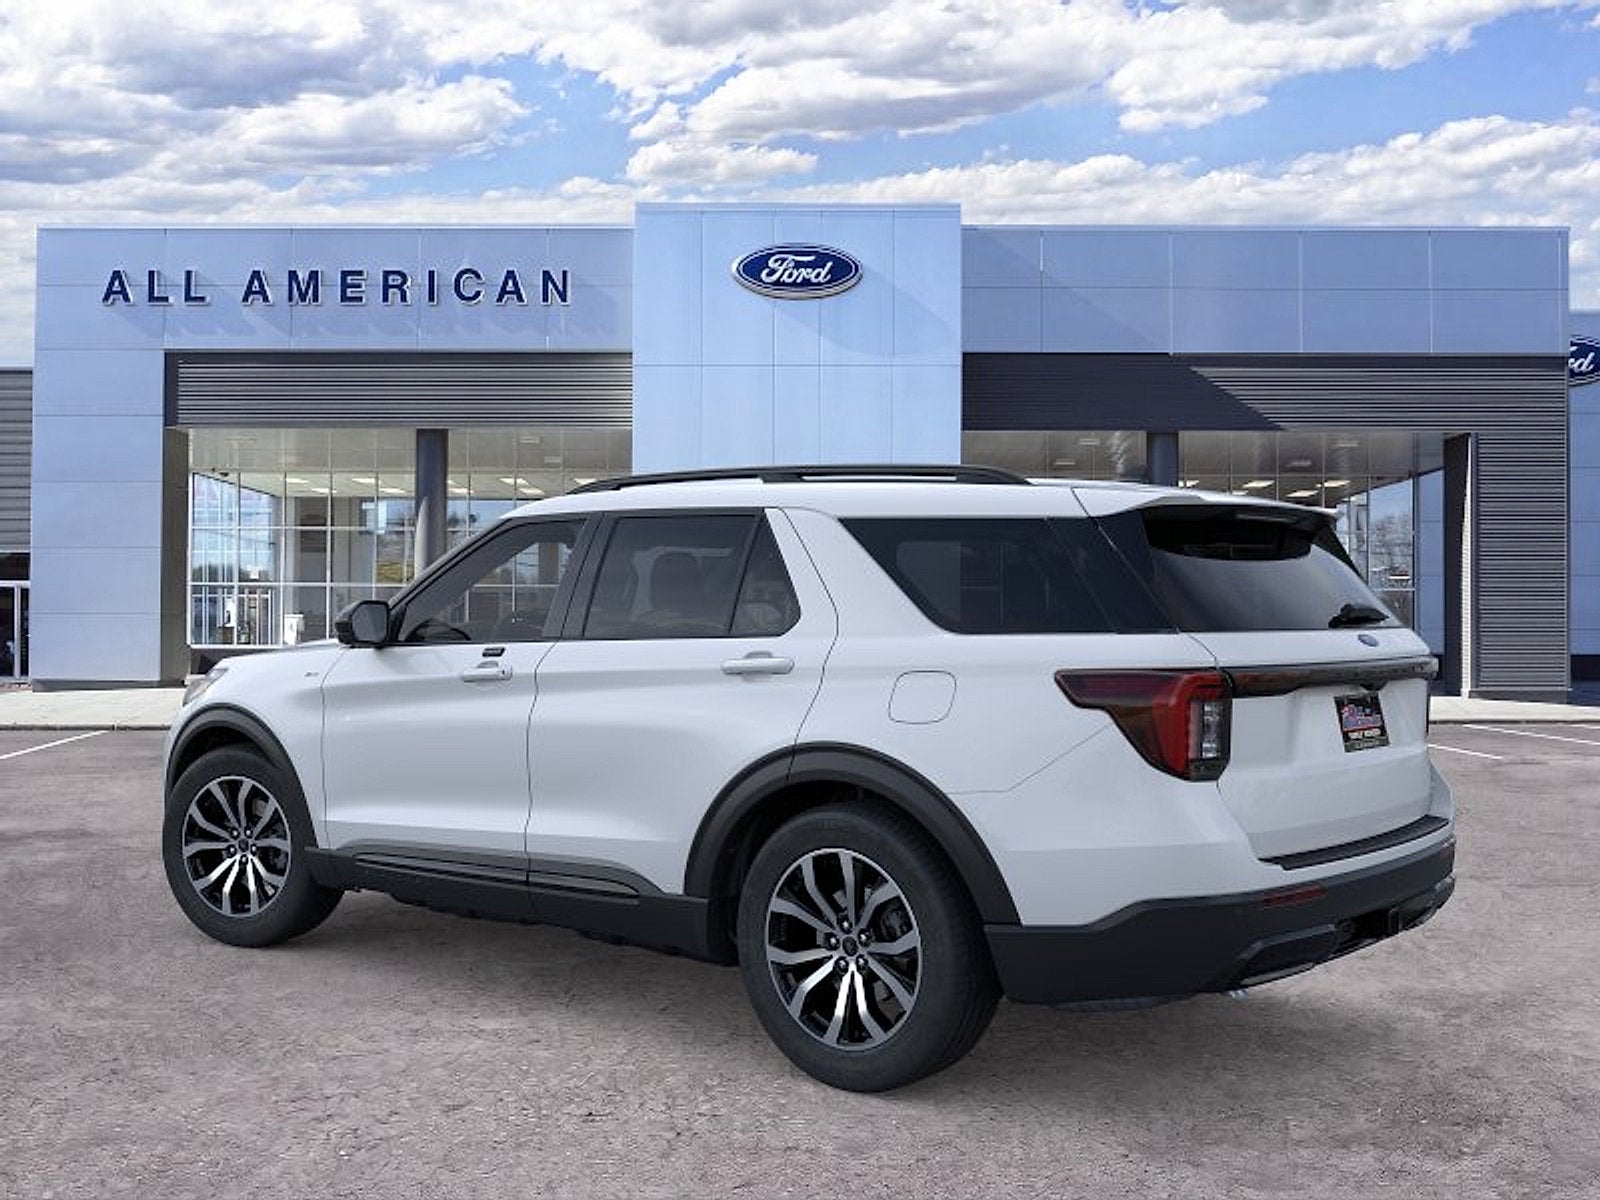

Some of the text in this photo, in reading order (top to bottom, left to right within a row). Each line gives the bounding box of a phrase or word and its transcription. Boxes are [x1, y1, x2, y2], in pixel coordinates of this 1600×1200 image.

[761, 253, 833, 283] Ford
[102, 268, 570, 304] ALL AMERICAN
[1568, 347, 1596, 373] rd
